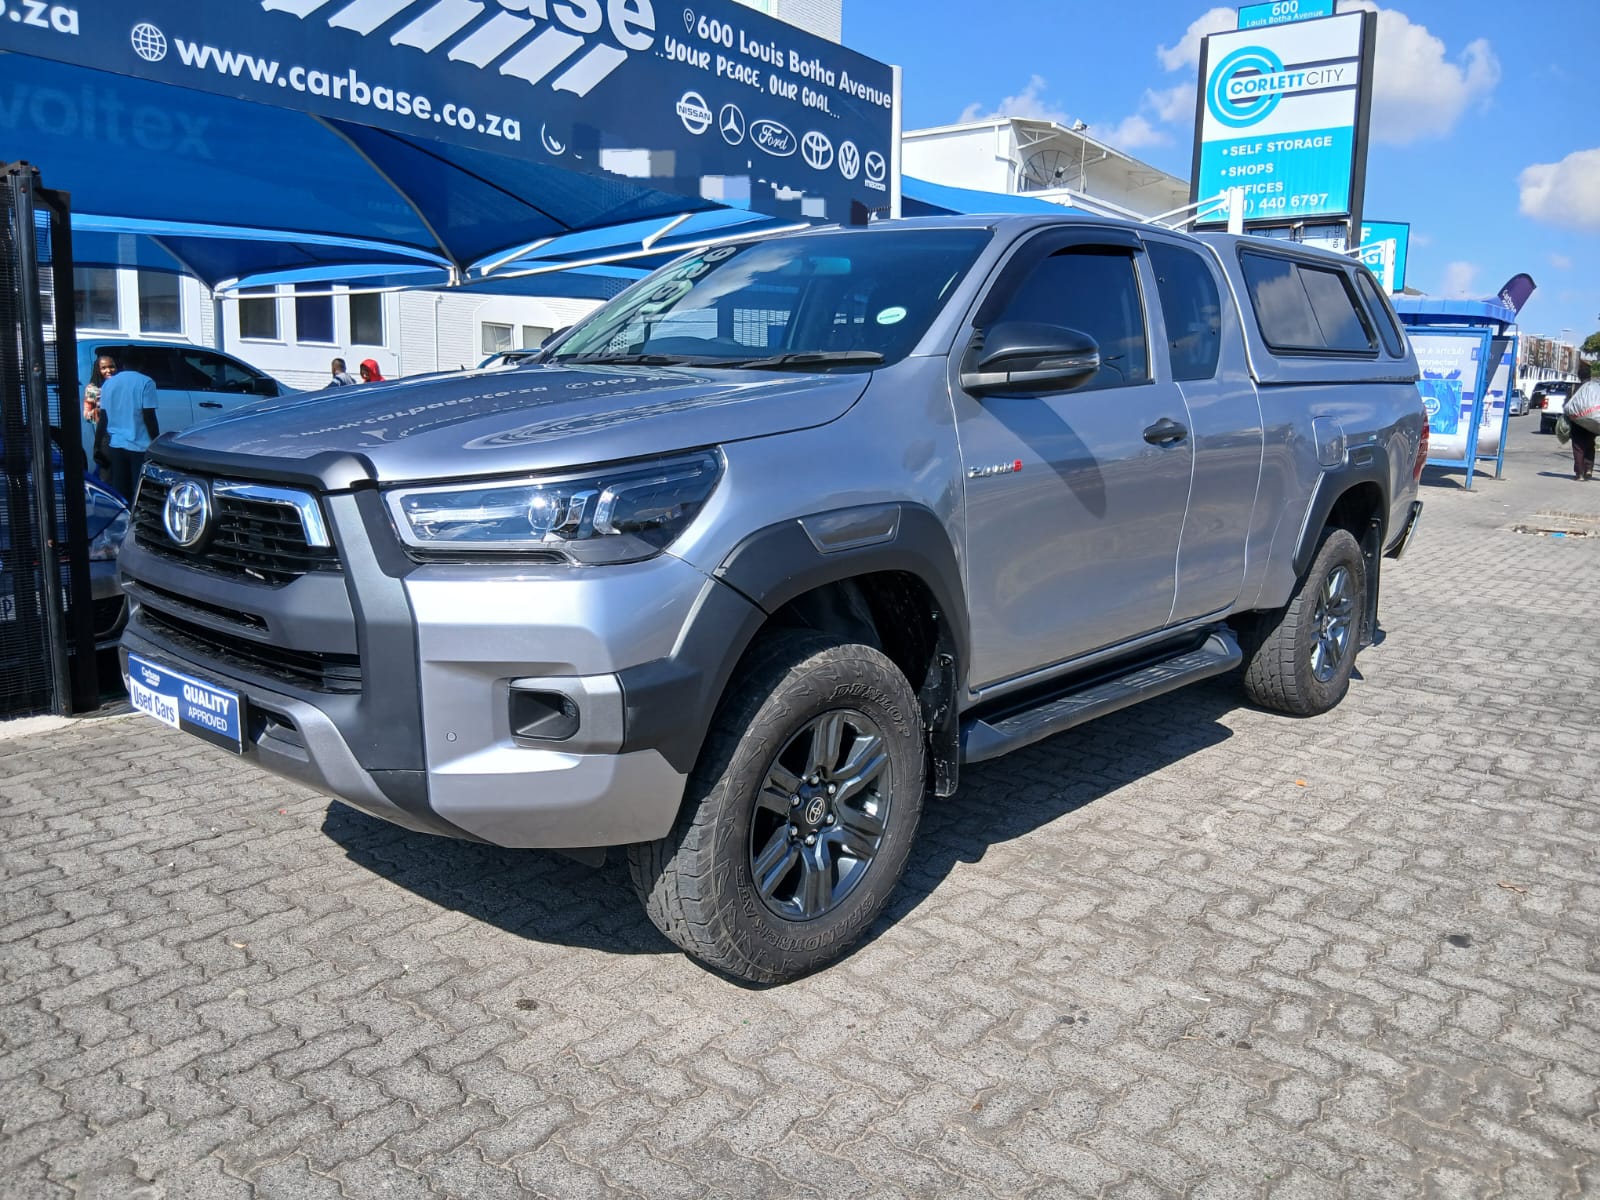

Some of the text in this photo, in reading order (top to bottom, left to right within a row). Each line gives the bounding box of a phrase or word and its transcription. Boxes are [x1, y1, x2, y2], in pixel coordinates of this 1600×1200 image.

[0, 0, 79, 35] .za
[1246, 10, 1324, 27] Louis Botha Avenue
[1271, 0, 1299, 16] 600
[697, 15, 892, 109] 600 Louis Botha Avenue
[174, 37, 522, 142] www.carbase.co.za
[716, 54, 764, 93] PEACE,
[769, 74, 798, 101] OUR
[678, 104, 711, 122] NISSAN
[758, 124, 788, 151] Ford
[1230, 135, 1333, 157] SELF STORAGE
[1228, 162, 1274, 177] SHOPS
[1258, 196, 1286, 210] 440
[1290, 192, 1329, 208] 6797
[132, 685, 175, 723] Used Cars
[183, 684, 229, 716] QUALITY
[828, 682, 911, 737] DUNLOP
[188, 706, 228, 732] APPROVED
